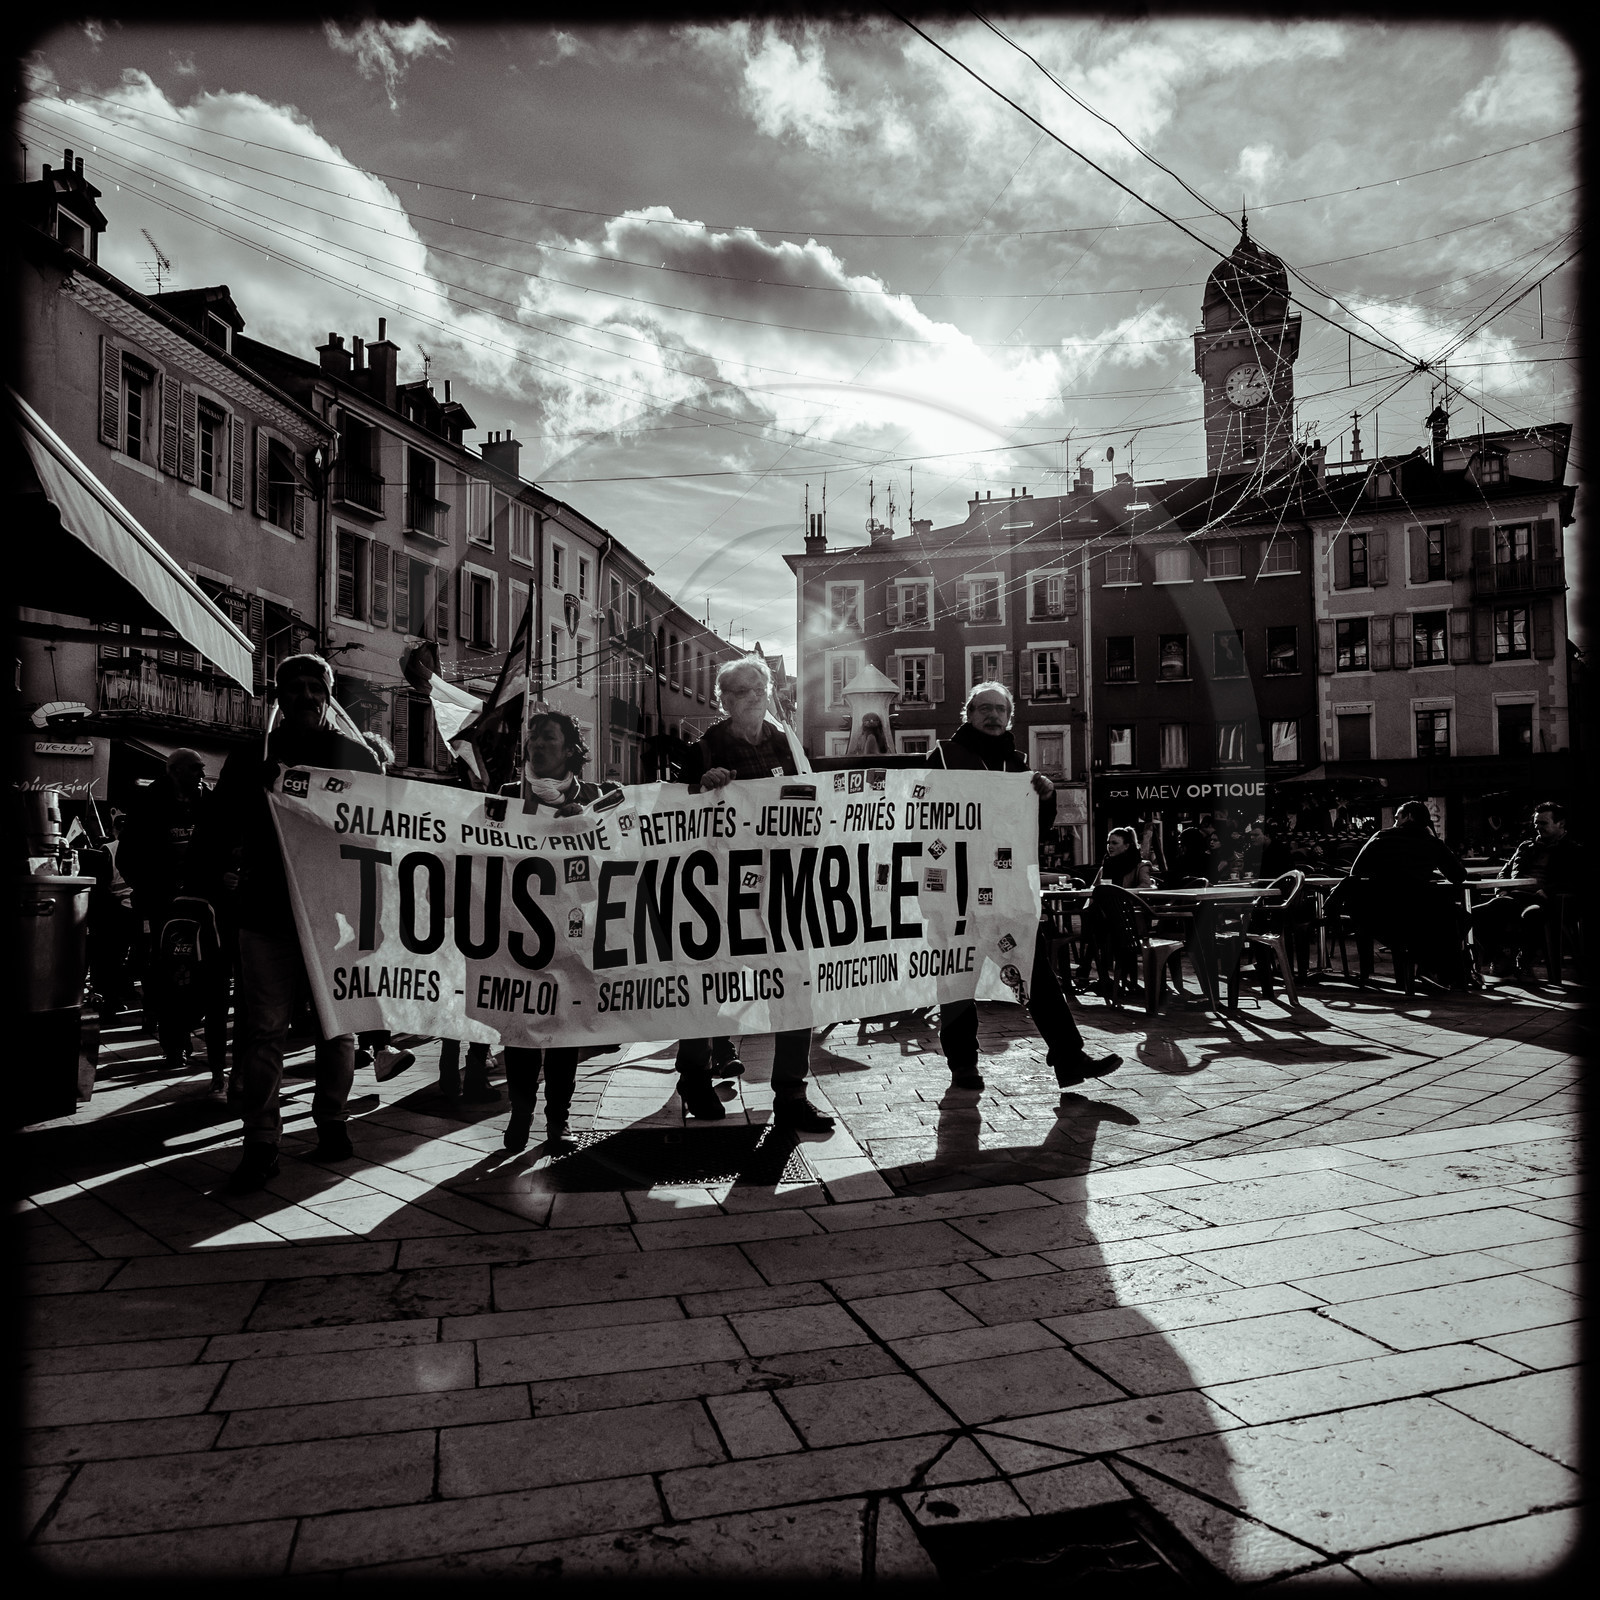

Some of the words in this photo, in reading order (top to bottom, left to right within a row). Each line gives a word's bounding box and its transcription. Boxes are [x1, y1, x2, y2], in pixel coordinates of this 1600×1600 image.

[284, 778, 308, 791] cgt
[850, 774, 862, 788] FO
[1136, 785, 1180, 799] MAEV
[1186, 782, 1266, 798] OPTIQUE
[334, 802, 447, 844] SALARIÉS
[461, 819, 611, 851] PUBLIC/PRIVÉ
[639, 800, 737, 847] RETRAITÉS
[756, 806, 823, 837] JEUNES
[843, 796, 896, 832] PRIVÉS
[905, 802, 982, 831] D'EMPLOI
[569, 859, 586, 877] FO
[978, 892, 993, 901] cgt
[340, 844, 558, 972] TOUS
[592, 842, 924, 971] ENSEMBLE
[568, 928, 582, 936] cgt
[333, 966, 441, 1003] SALAIRES
[476, 974, 559, 1016] EMPLOI
[597, 975, 690, 1014] SERVICES
[701, 967, 785, 1006] PUBLICS
[817, 952, 899, 994] PROTECTION
[908, 945, 977, 979] SOCIALE
